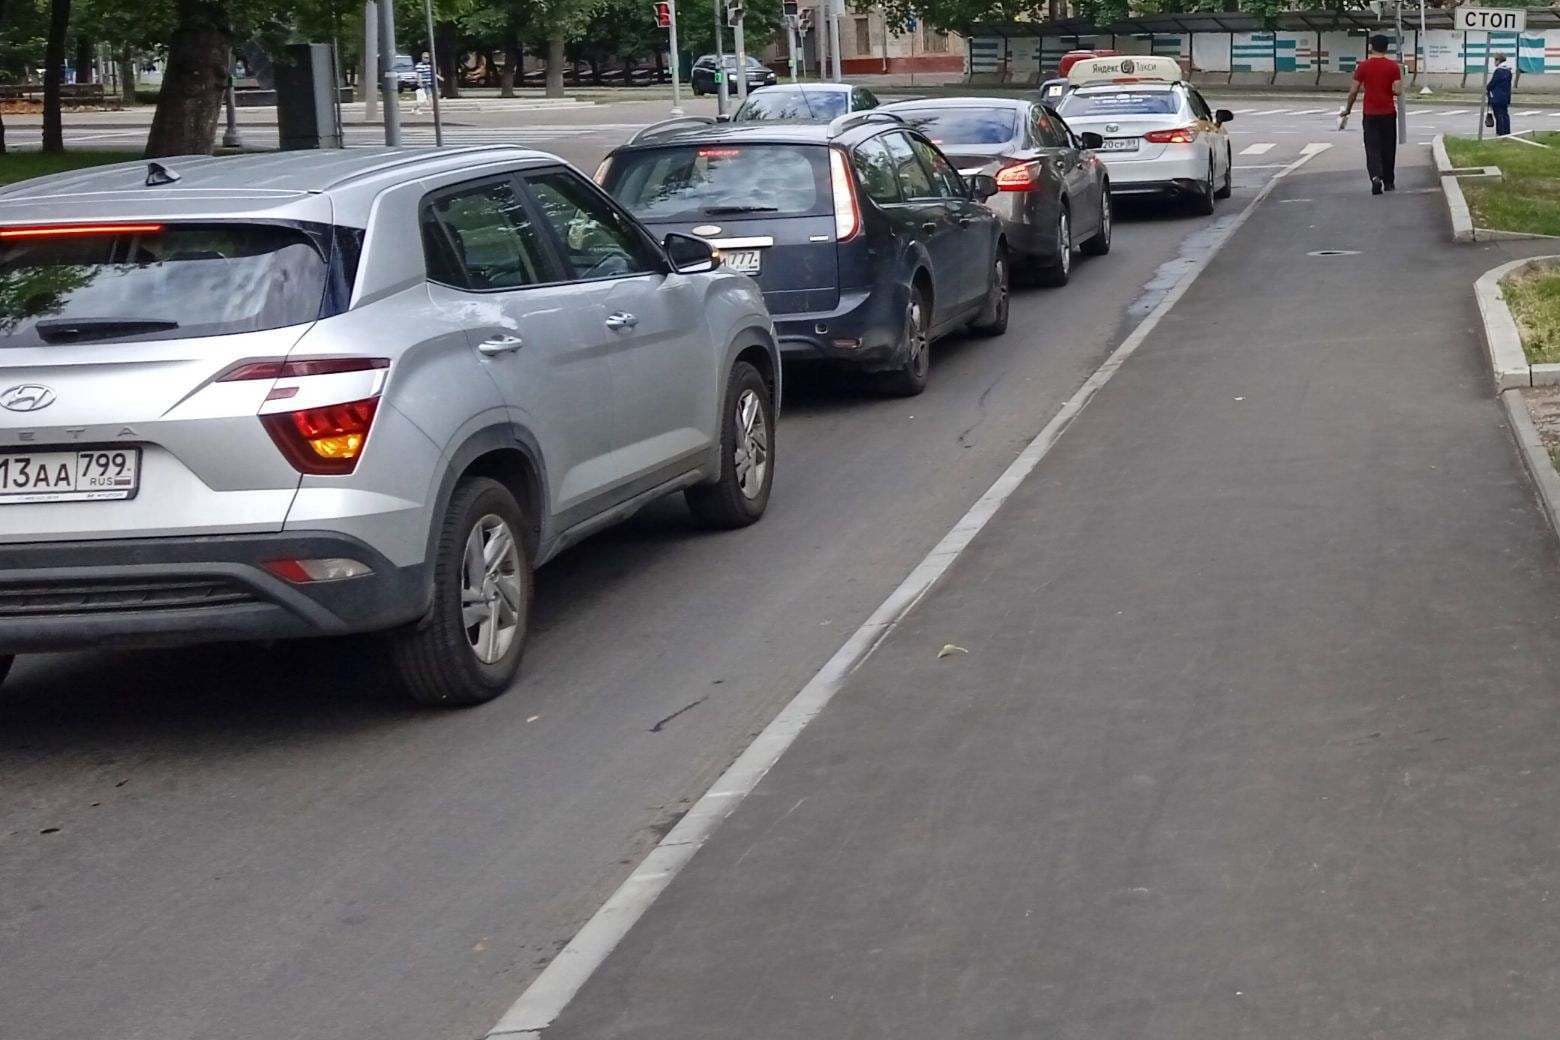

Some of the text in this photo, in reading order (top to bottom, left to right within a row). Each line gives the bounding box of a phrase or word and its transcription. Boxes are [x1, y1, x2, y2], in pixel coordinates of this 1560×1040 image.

[1466, 12, 1515, 28] СТОП
[1092, 63, 1119, 73] Яндекс
[730, 251, 755, 265] 777
[80, 452, 127, 477] 799
[90, 476, 113, 486] RUS
